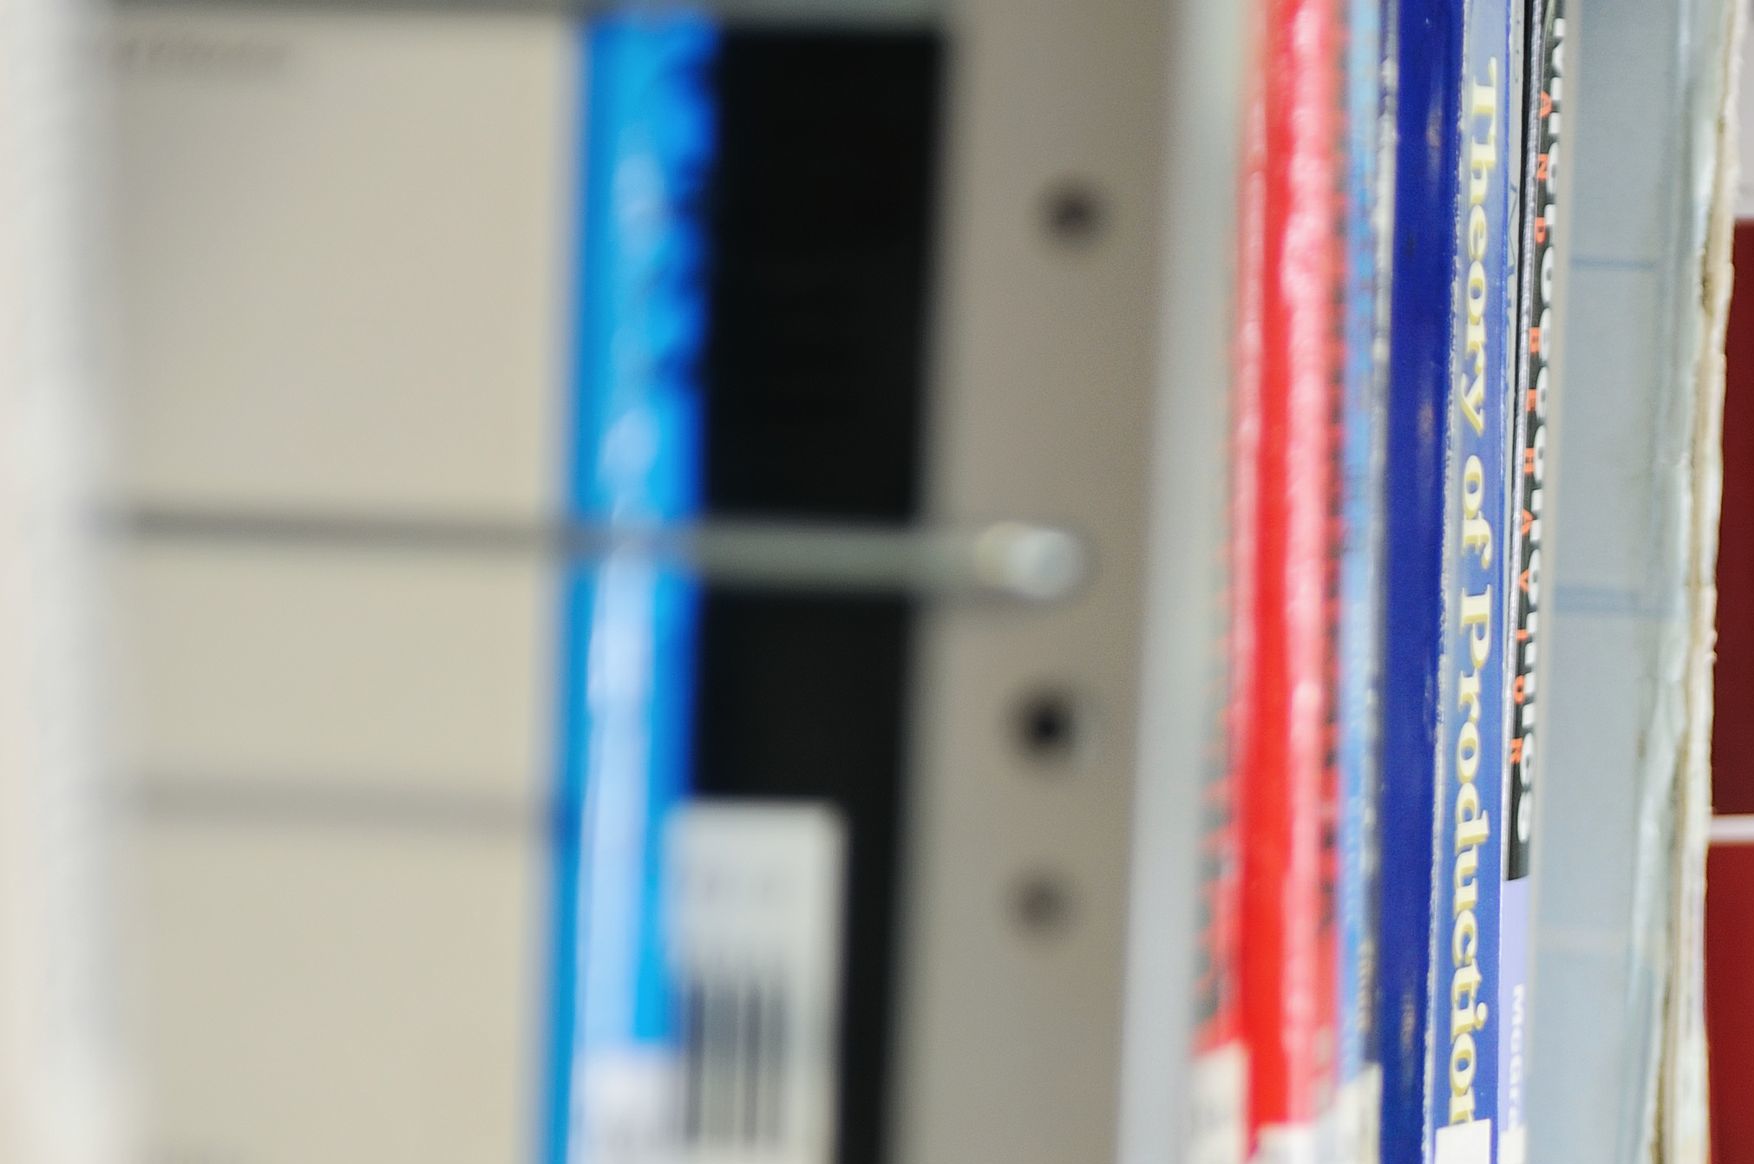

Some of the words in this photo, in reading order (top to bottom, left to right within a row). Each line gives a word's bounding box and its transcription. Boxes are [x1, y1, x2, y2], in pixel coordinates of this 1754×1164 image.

[1459, 56, 1498, 434] Theory
[1535, 90, 1552, 245] AND
[1460, 453, 1494, 570] of
